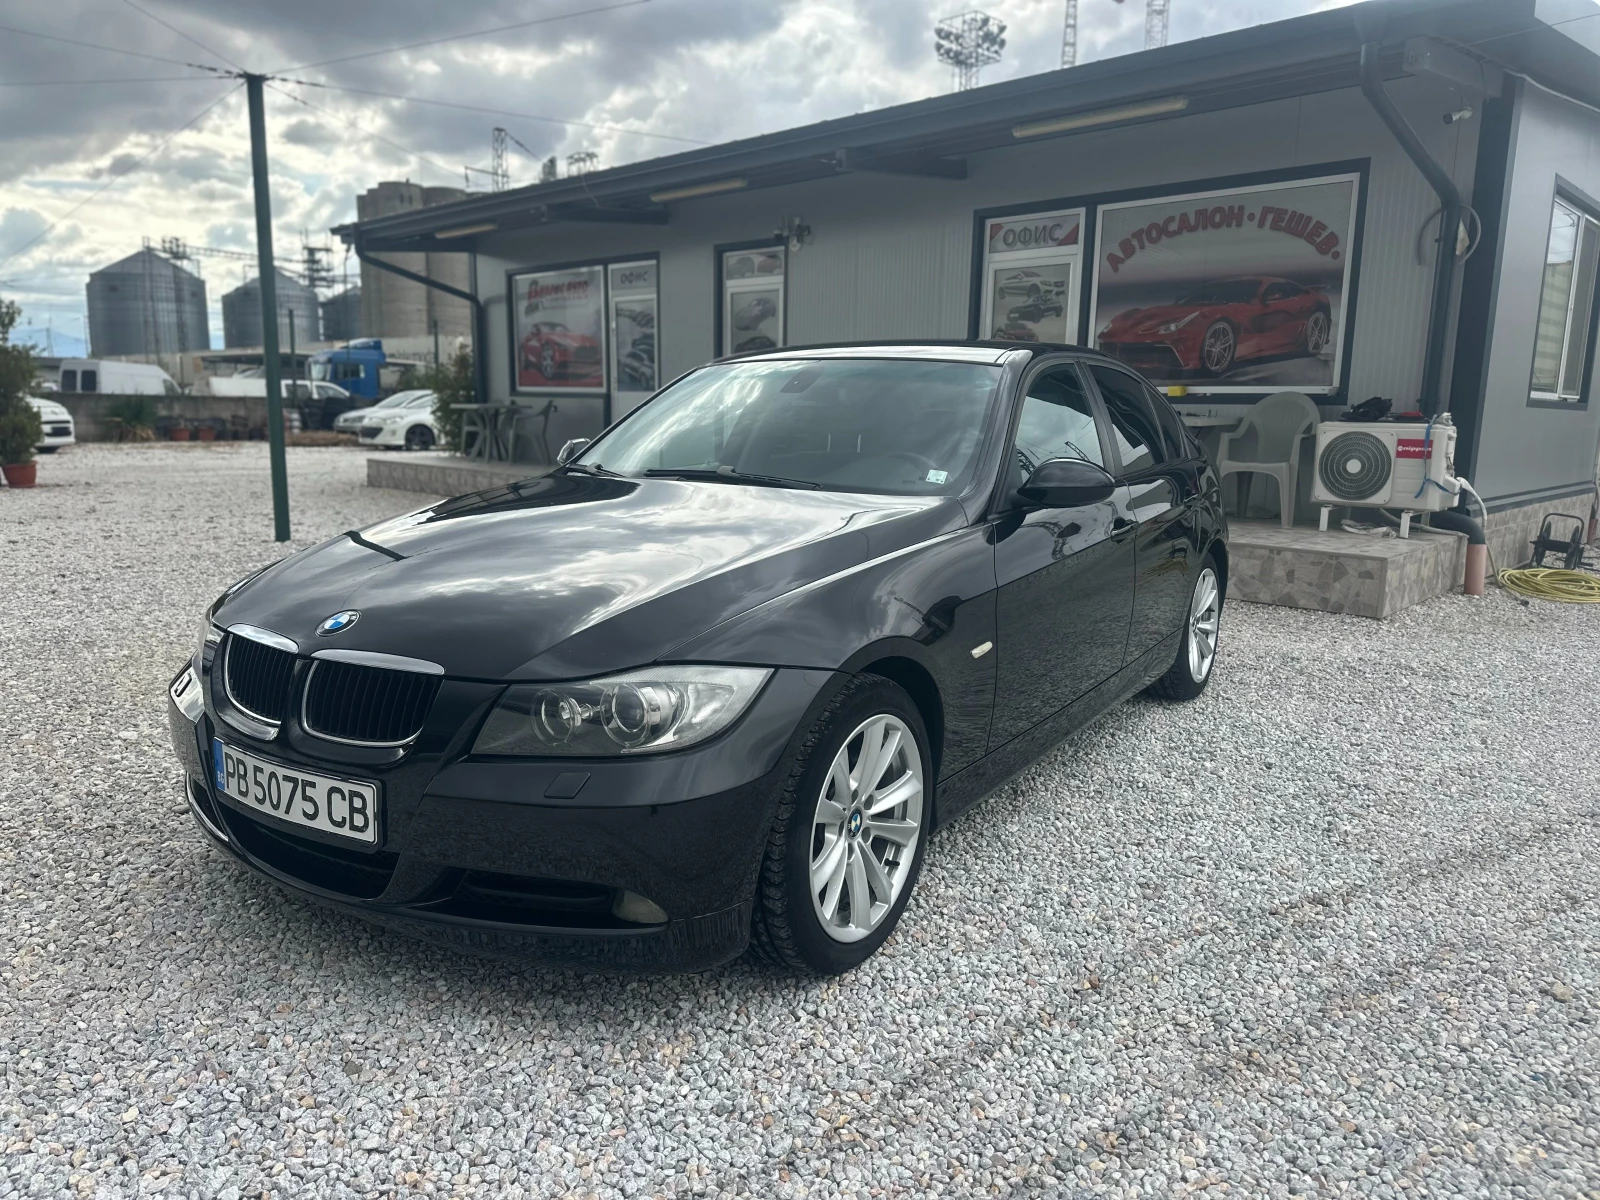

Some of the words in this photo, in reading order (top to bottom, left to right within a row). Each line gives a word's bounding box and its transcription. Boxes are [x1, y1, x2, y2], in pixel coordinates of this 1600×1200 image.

[1003, 223, 1063, 247] ОФИС
[1106, 205, 1245, 273] АВТОСАЛОН
[1257, 206, 1341, 257] ГЕШЕВ
[620, 271, 648, 284] ОФИС
[224, 751, 249, 798] PB
[253, 765, 320, 821] 5075
[326, 785, 370, 833] CB
